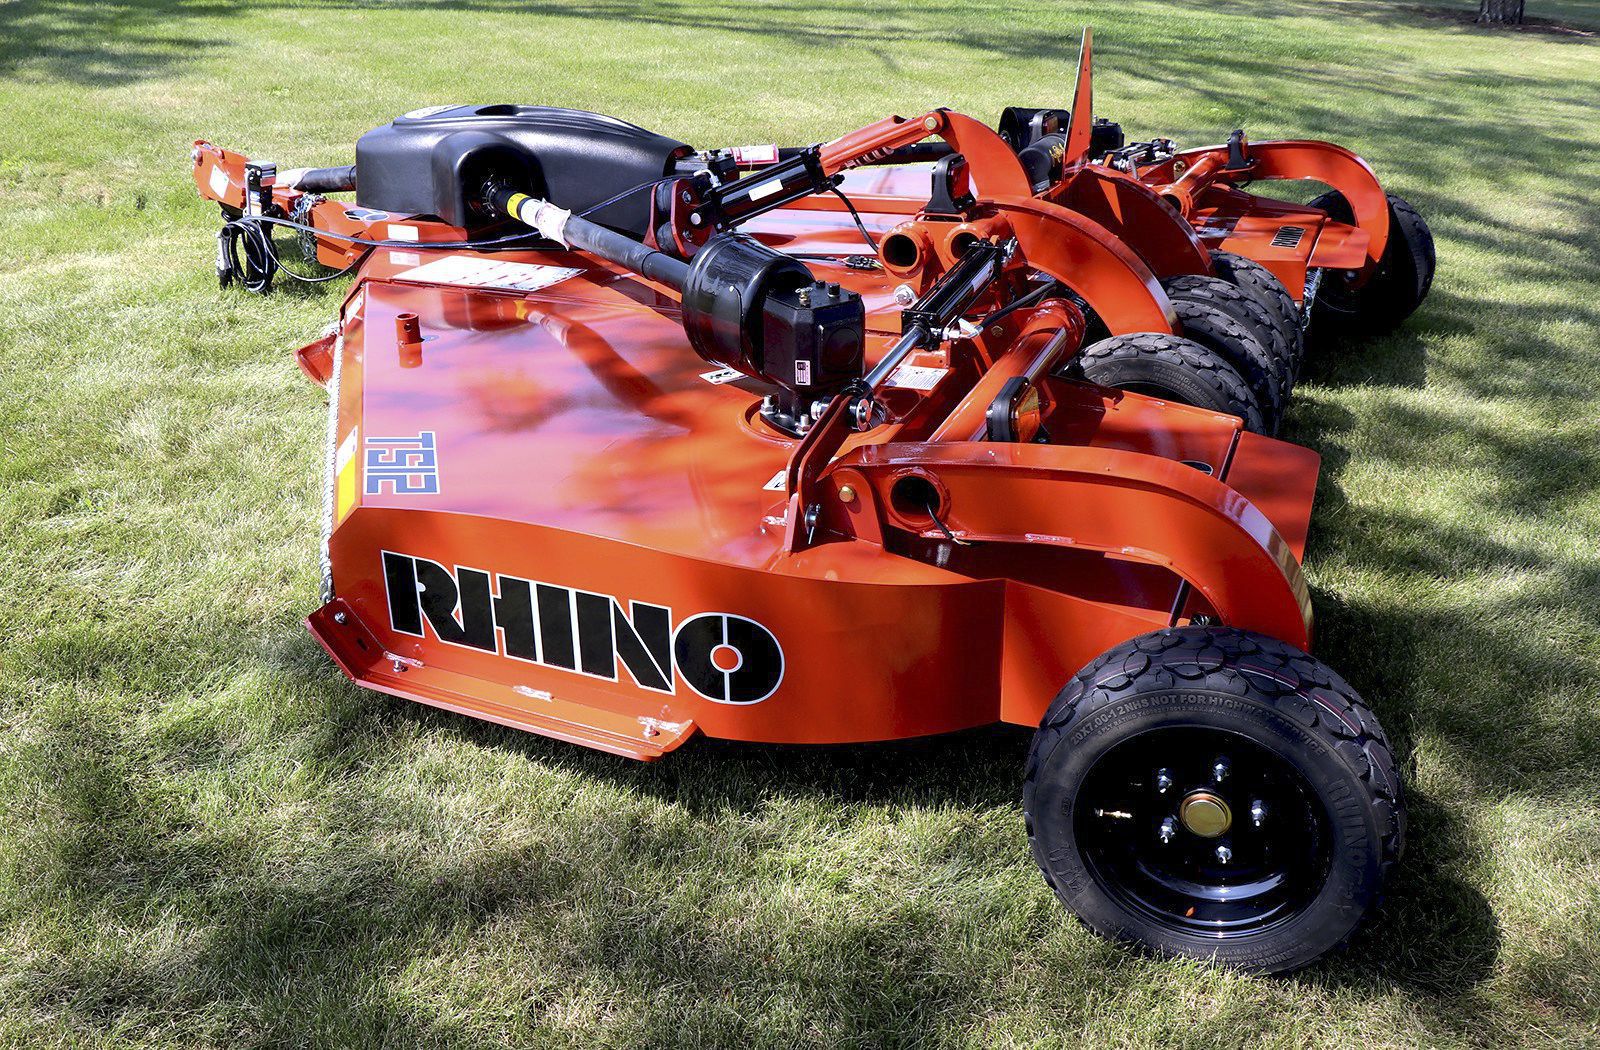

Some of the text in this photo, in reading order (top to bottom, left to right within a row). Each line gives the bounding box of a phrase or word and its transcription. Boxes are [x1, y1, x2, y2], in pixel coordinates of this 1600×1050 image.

[381, 549, 786, 706] RHINO
[1148, 693, 1178, 706] NOT
[1178, 693, 1206, 705] FOR
